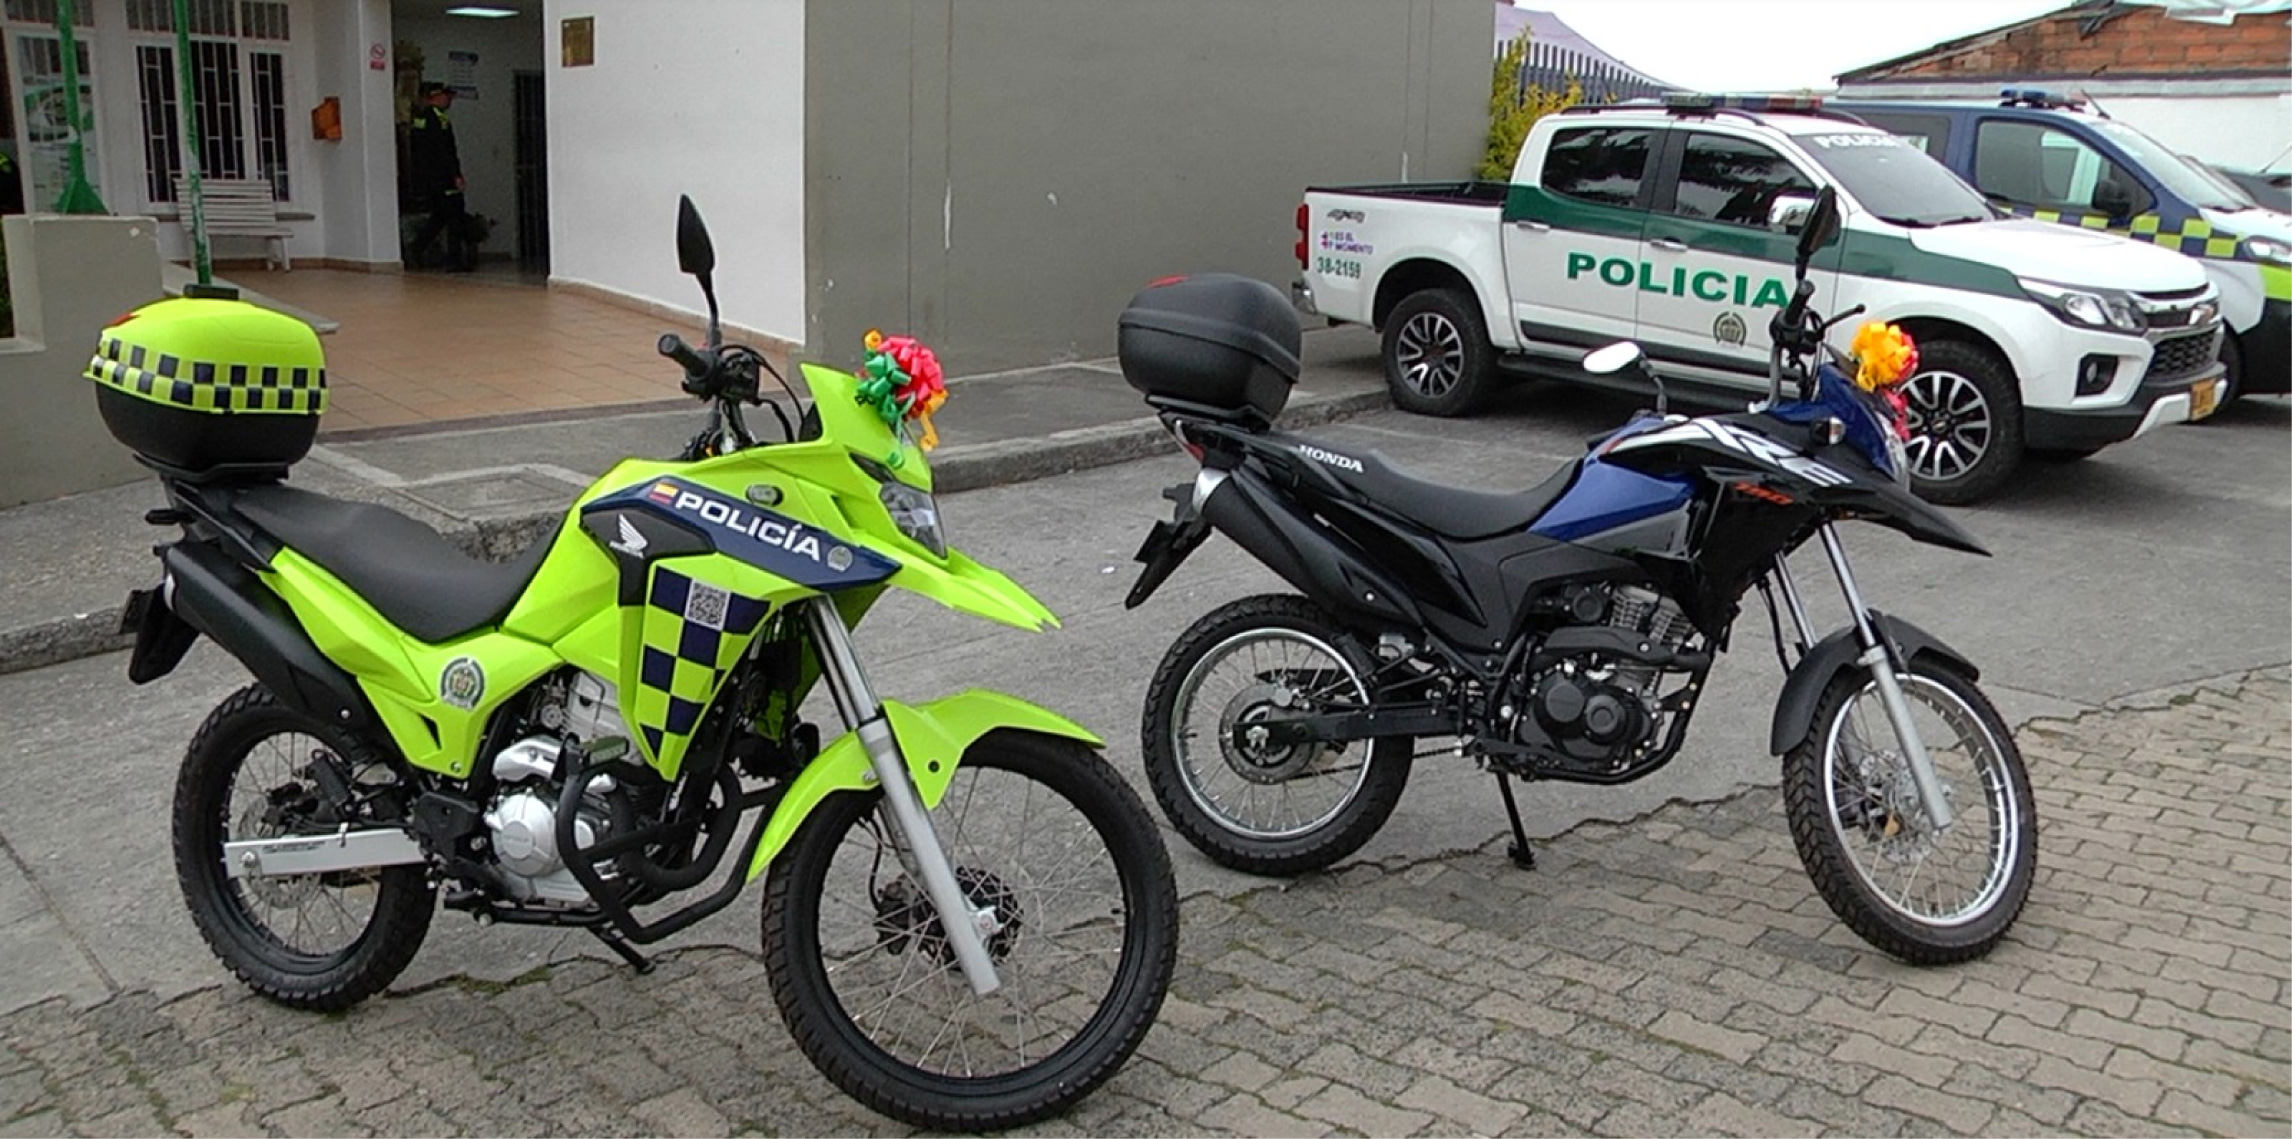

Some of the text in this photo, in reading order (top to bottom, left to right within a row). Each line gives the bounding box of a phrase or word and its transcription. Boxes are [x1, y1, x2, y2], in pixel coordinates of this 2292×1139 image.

[1566, 252, 1790, 309] POLICIA
[1299, 443, 1363, 474] HONDA
[675, 490, 820, 562] POLICÍA
